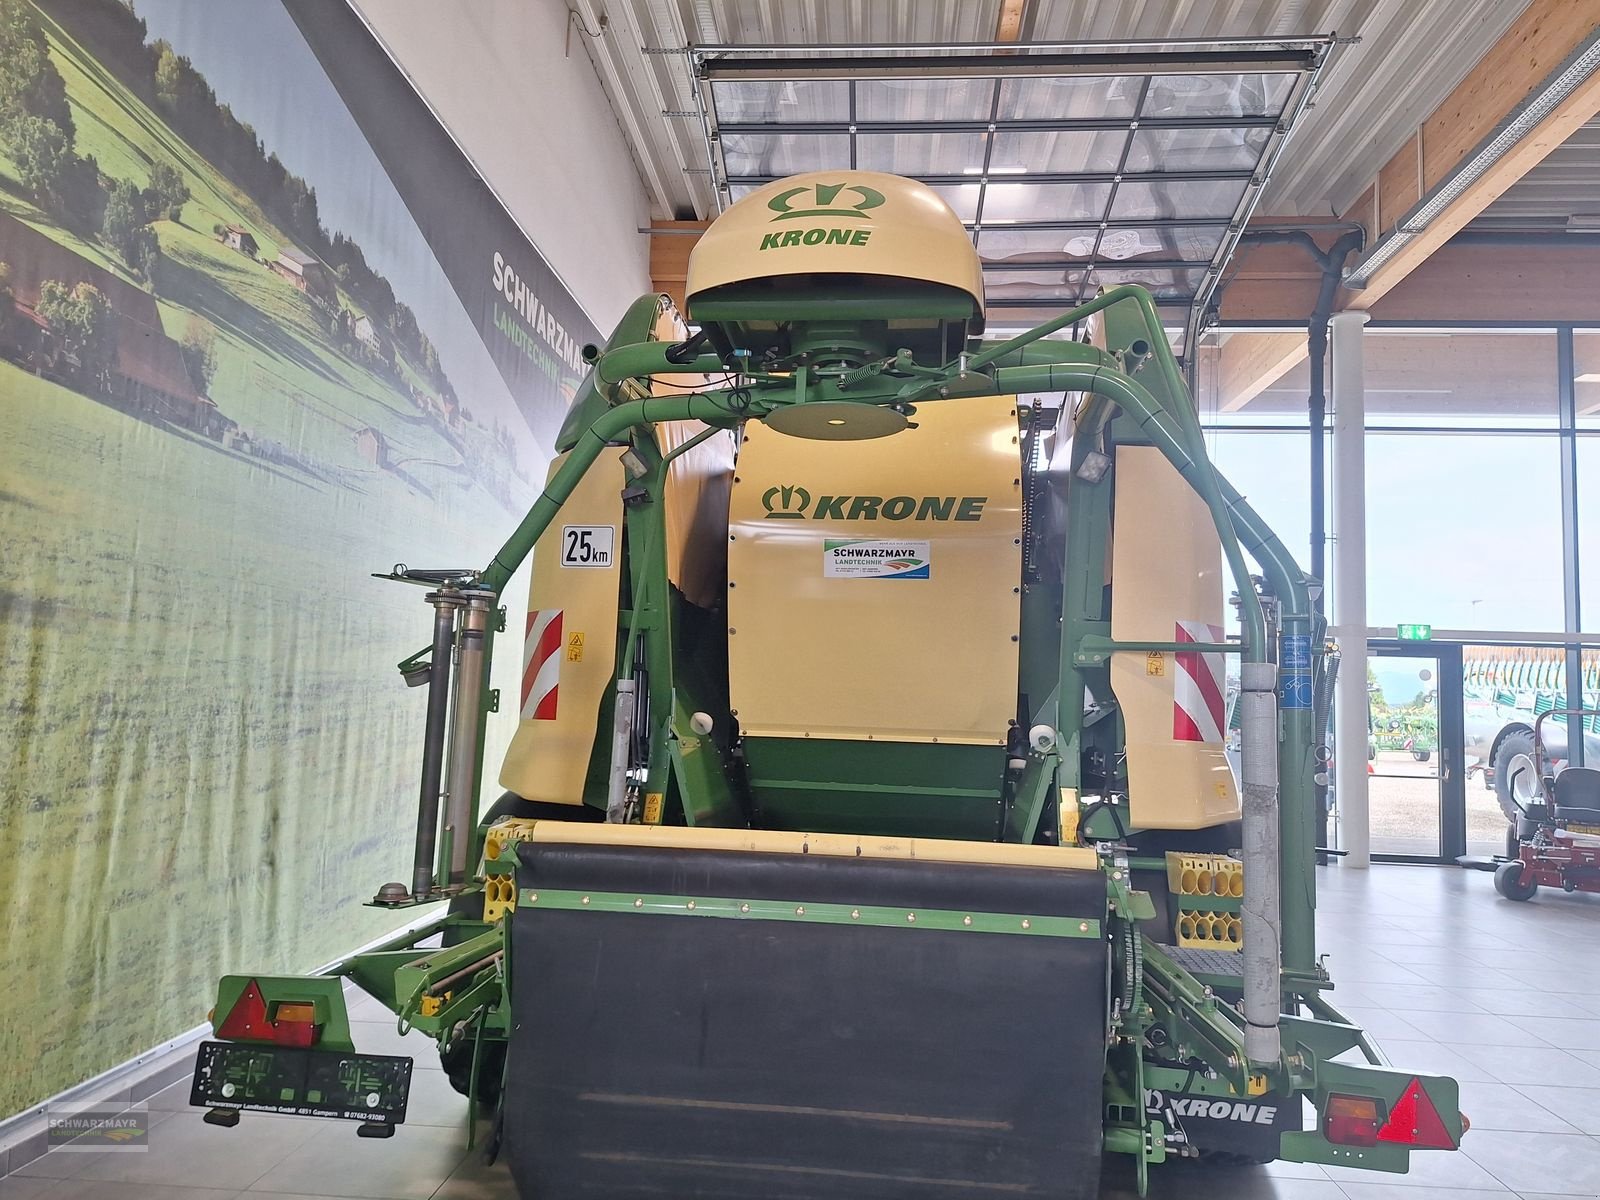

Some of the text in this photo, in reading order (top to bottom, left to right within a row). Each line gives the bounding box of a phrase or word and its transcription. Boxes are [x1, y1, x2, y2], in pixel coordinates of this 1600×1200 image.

[759, 228, 872, 251] KRONE
[812, 495, 988, 521] KRONE
[833, 548, 916, 558] SCHWARZMAYR
[205, 1100, 243, 1110] Schwarzmayr
[243, 1103, 278, 1112] Landtechnik
[278, 1106, 296, 1114] GmbH
[312, 1109, 338, 1117] Gampern
[1169, 1098, 1278, 1126] KRONE
